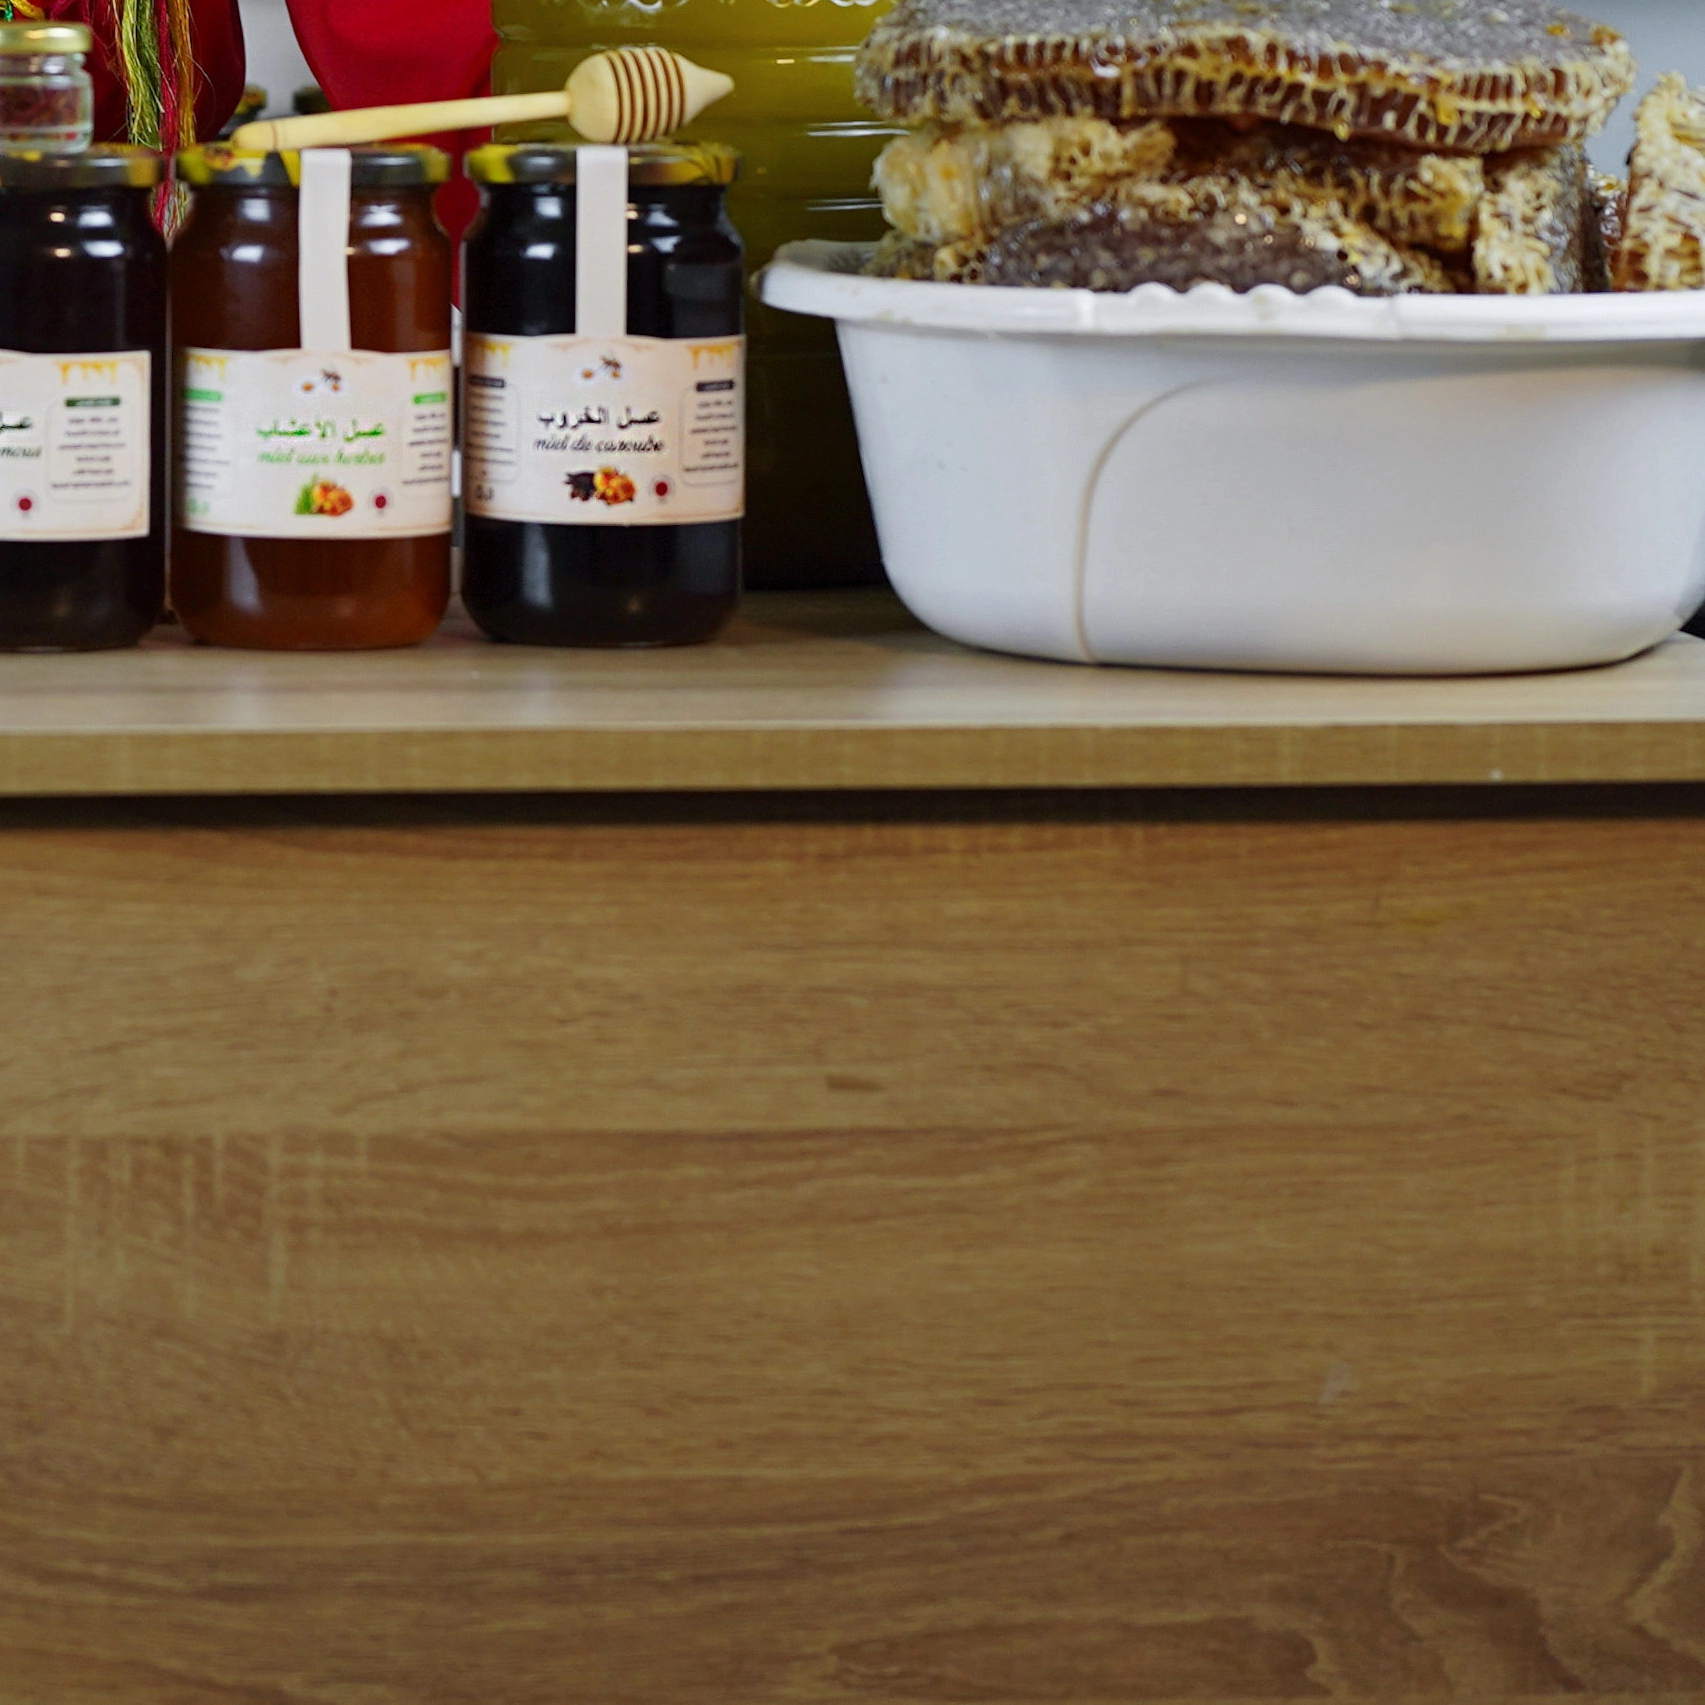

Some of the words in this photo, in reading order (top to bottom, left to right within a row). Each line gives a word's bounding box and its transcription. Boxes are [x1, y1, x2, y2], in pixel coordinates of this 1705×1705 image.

[344, 417, 386, 444] عسل
[535, 406, 611, 431] الخروب
[615, 406, 662, 431] عسل
